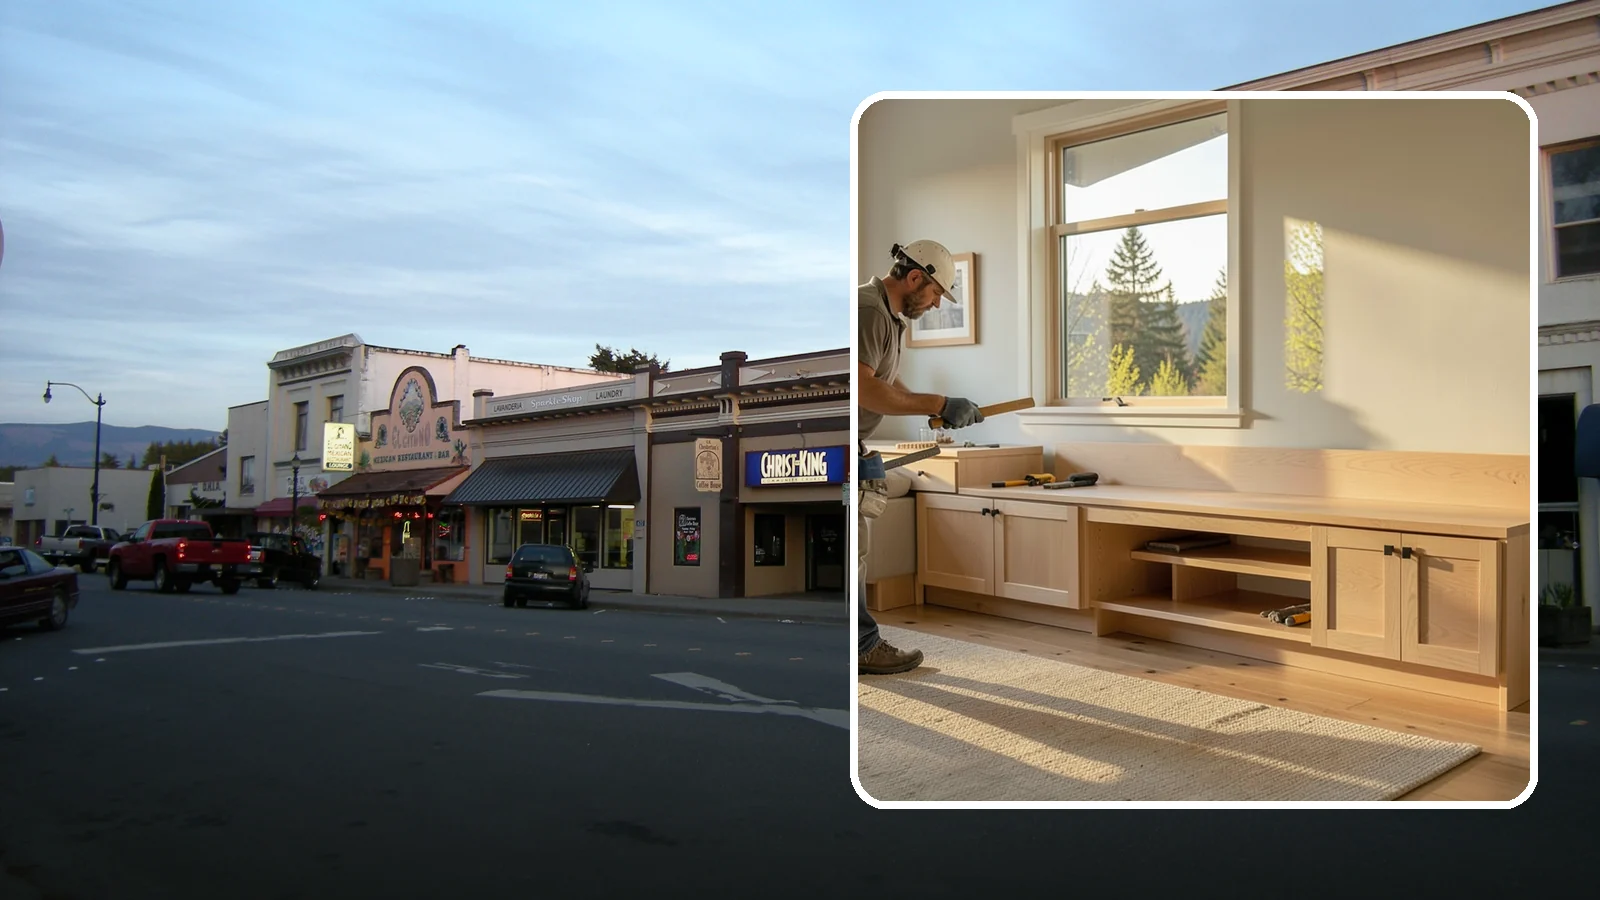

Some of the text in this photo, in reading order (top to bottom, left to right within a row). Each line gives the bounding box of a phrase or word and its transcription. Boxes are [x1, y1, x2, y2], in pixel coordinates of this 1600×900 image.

[595, 388, 624, 400] LAUNDRY
[494, 402, 522, 412] LAVANDERIA
[374, 450, 450, 464] MEXICAN RESTAURANT BAR
[761, 450, 828, 478] CHRIST KING
